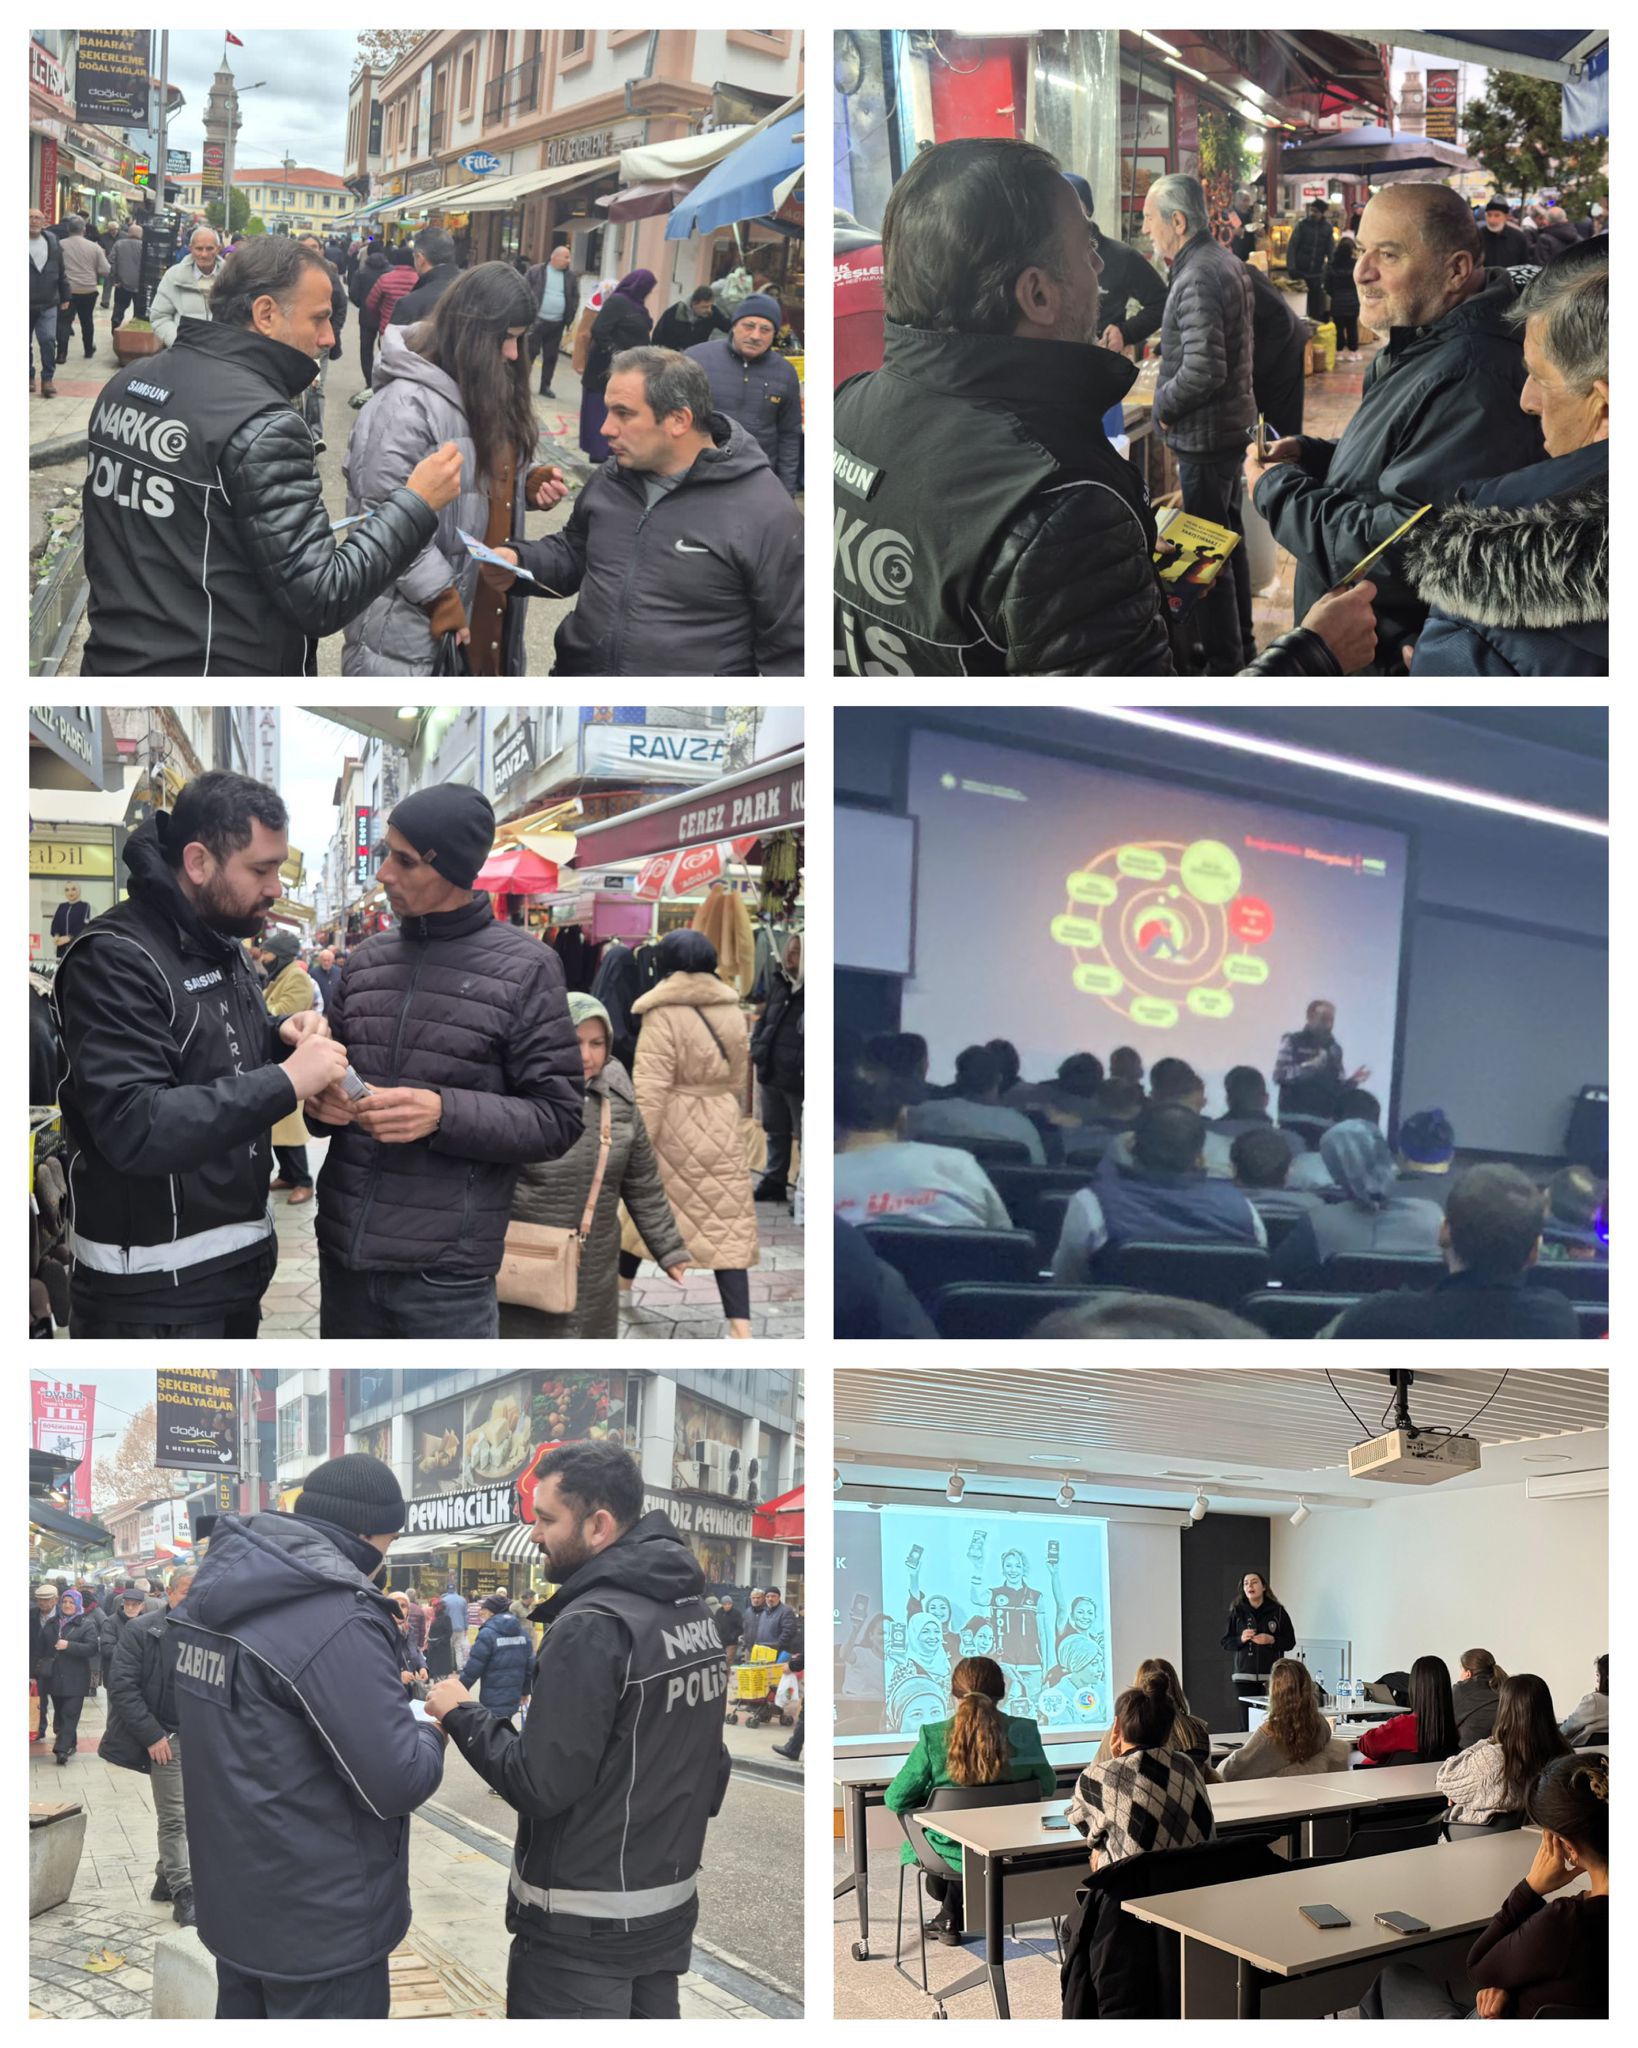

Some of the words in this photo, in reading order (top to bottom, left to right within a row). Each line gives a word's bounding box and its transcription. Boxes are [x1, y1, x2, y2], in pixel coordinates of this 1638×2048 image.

[80, 37, 134, 51] BAHARAT
[495, 744, 530, 788] RAVZA
[731, 786, 780, 829] PARK
[158, 1377, 231, 1398] ŞEKERLEME
[170, 1426, 220, 1440] doğkur
[176, 1641, 226, 1689] ZABITA
